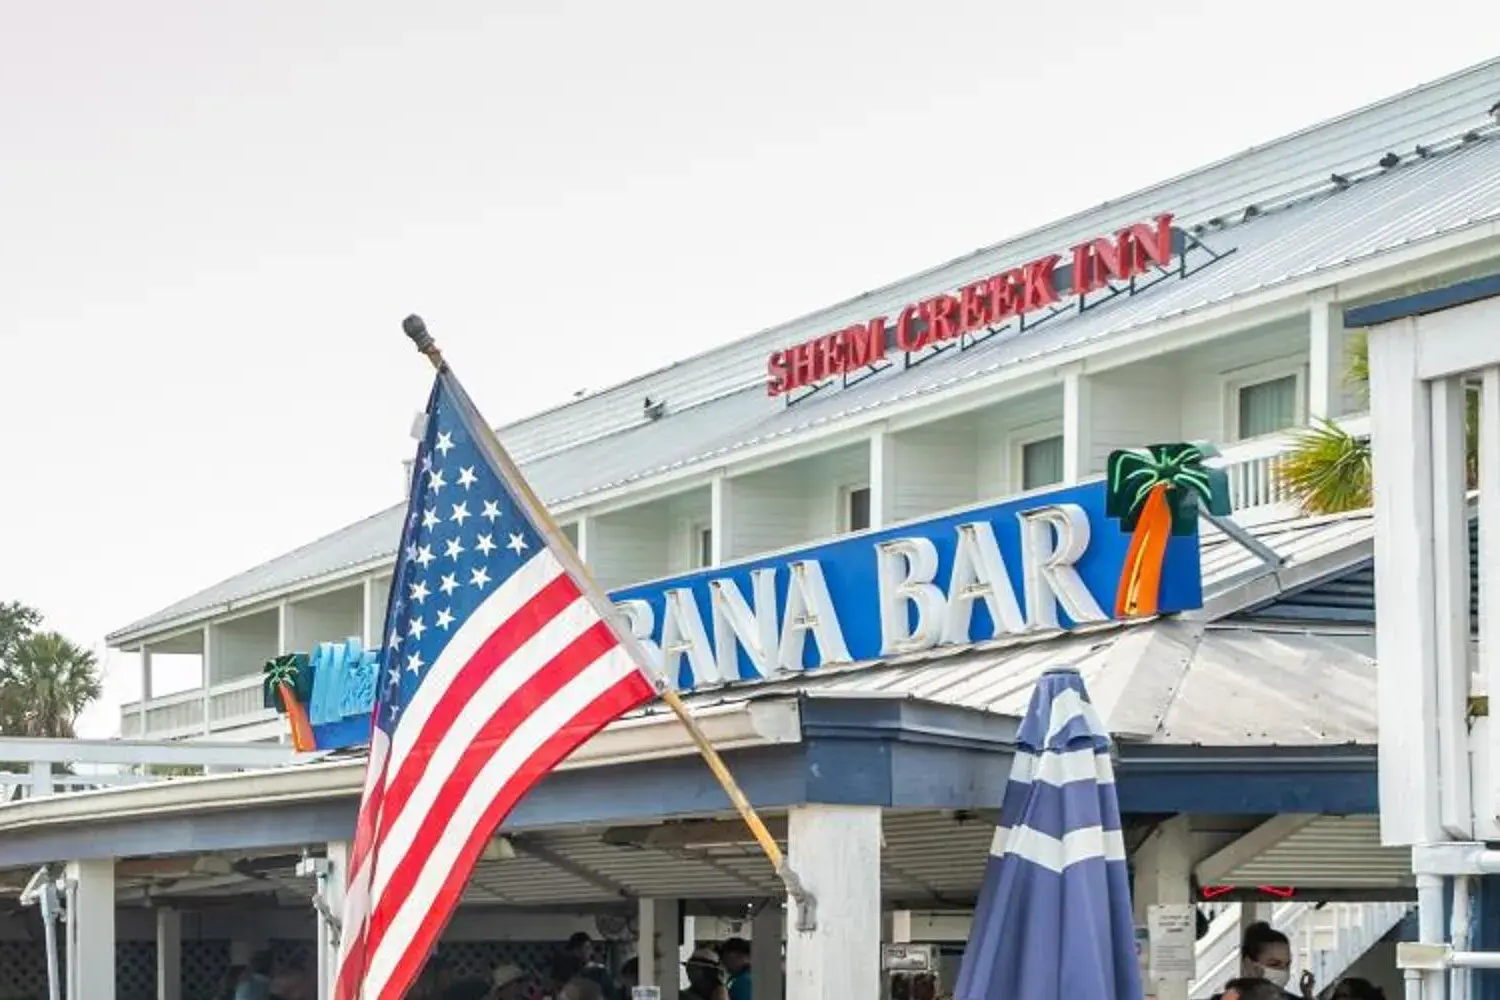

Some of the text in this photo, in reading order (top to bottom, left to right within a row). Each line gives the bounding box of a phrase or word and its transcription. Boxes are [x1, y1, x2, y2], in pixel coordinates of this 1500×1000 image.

[767, 211, 1176, 397] SHEM CREEK INN
[874, 502, 1110, 656] BAR
